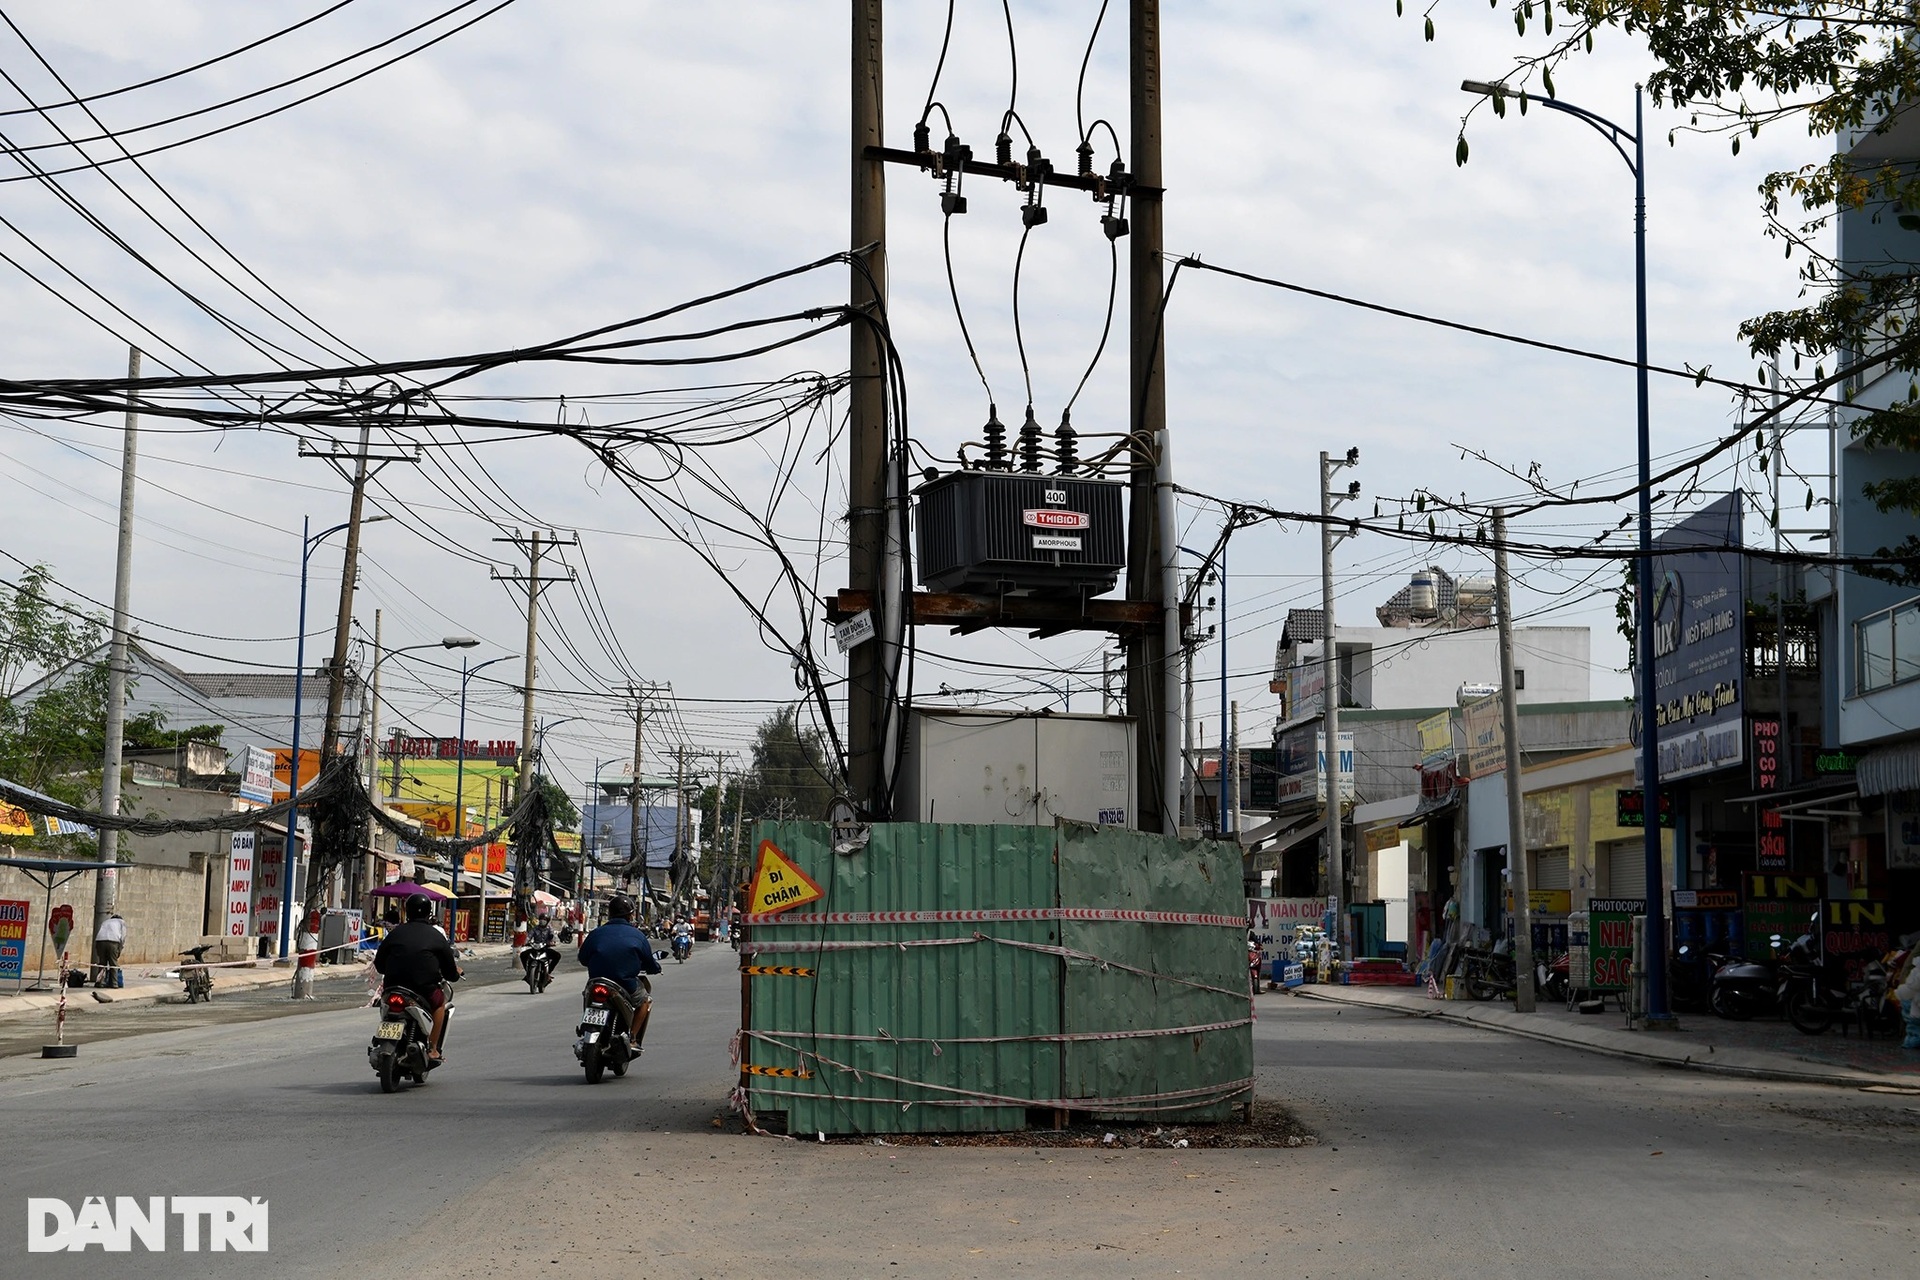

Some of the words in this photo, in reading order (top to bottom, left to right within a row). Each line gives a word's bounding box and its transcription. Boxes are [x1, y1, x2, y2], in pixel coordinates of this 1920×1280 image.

[1046, 492, 1065, 502] 400
[1040, 514, 1077, 525] THIBIDI
[1038, 539, 1077, 547] AMORPHOUS
[1685, 623, 1699, 646] NGÔ
[1754, 721, 1779, 736] PHO
[487, 740, 516, 757] ANH
[1759, 740, 1775, 754] TO
[1318, 750, 1353, 773] NM
[1759, 757, 1776, 771] CO
[1760, 775, 1776, 789] PY
[241, 834, 253, 849] BÁN
[1760, 831, 1786, 856] SÁCH
[233, 859, 250, 871] TIVI
[262, 848, 282, 867] ĐIỆN
[264, 869, 277, 888] TỬ
[769, 870, 783, 884] ĐI
[231, 880, 250, 892] AMPLY
[1751, 875, 1818, 898] IN
[763, 885, 801, 906] CHẬM
[1697, 894, 1736, 907] JOTUN
[0, 902, 25, 920] HÓA
[230, 901, 247, 914] LOA
[261, 894, 278, 914] ĐIỆN
[1270, 900, 1297, 918] MÀN
[1591, 900, 1645, 912] PHOTOCOPY
[1829, 902, 1886, 926] IN
[0, 923, 22, 938] GÂN
[231, 920, 244, 935] CŨ
[1, 947, 17, 957] BIA
[0, 961, 19, 973] GỌT
[1593, 950, 1633, 986] SÁC
